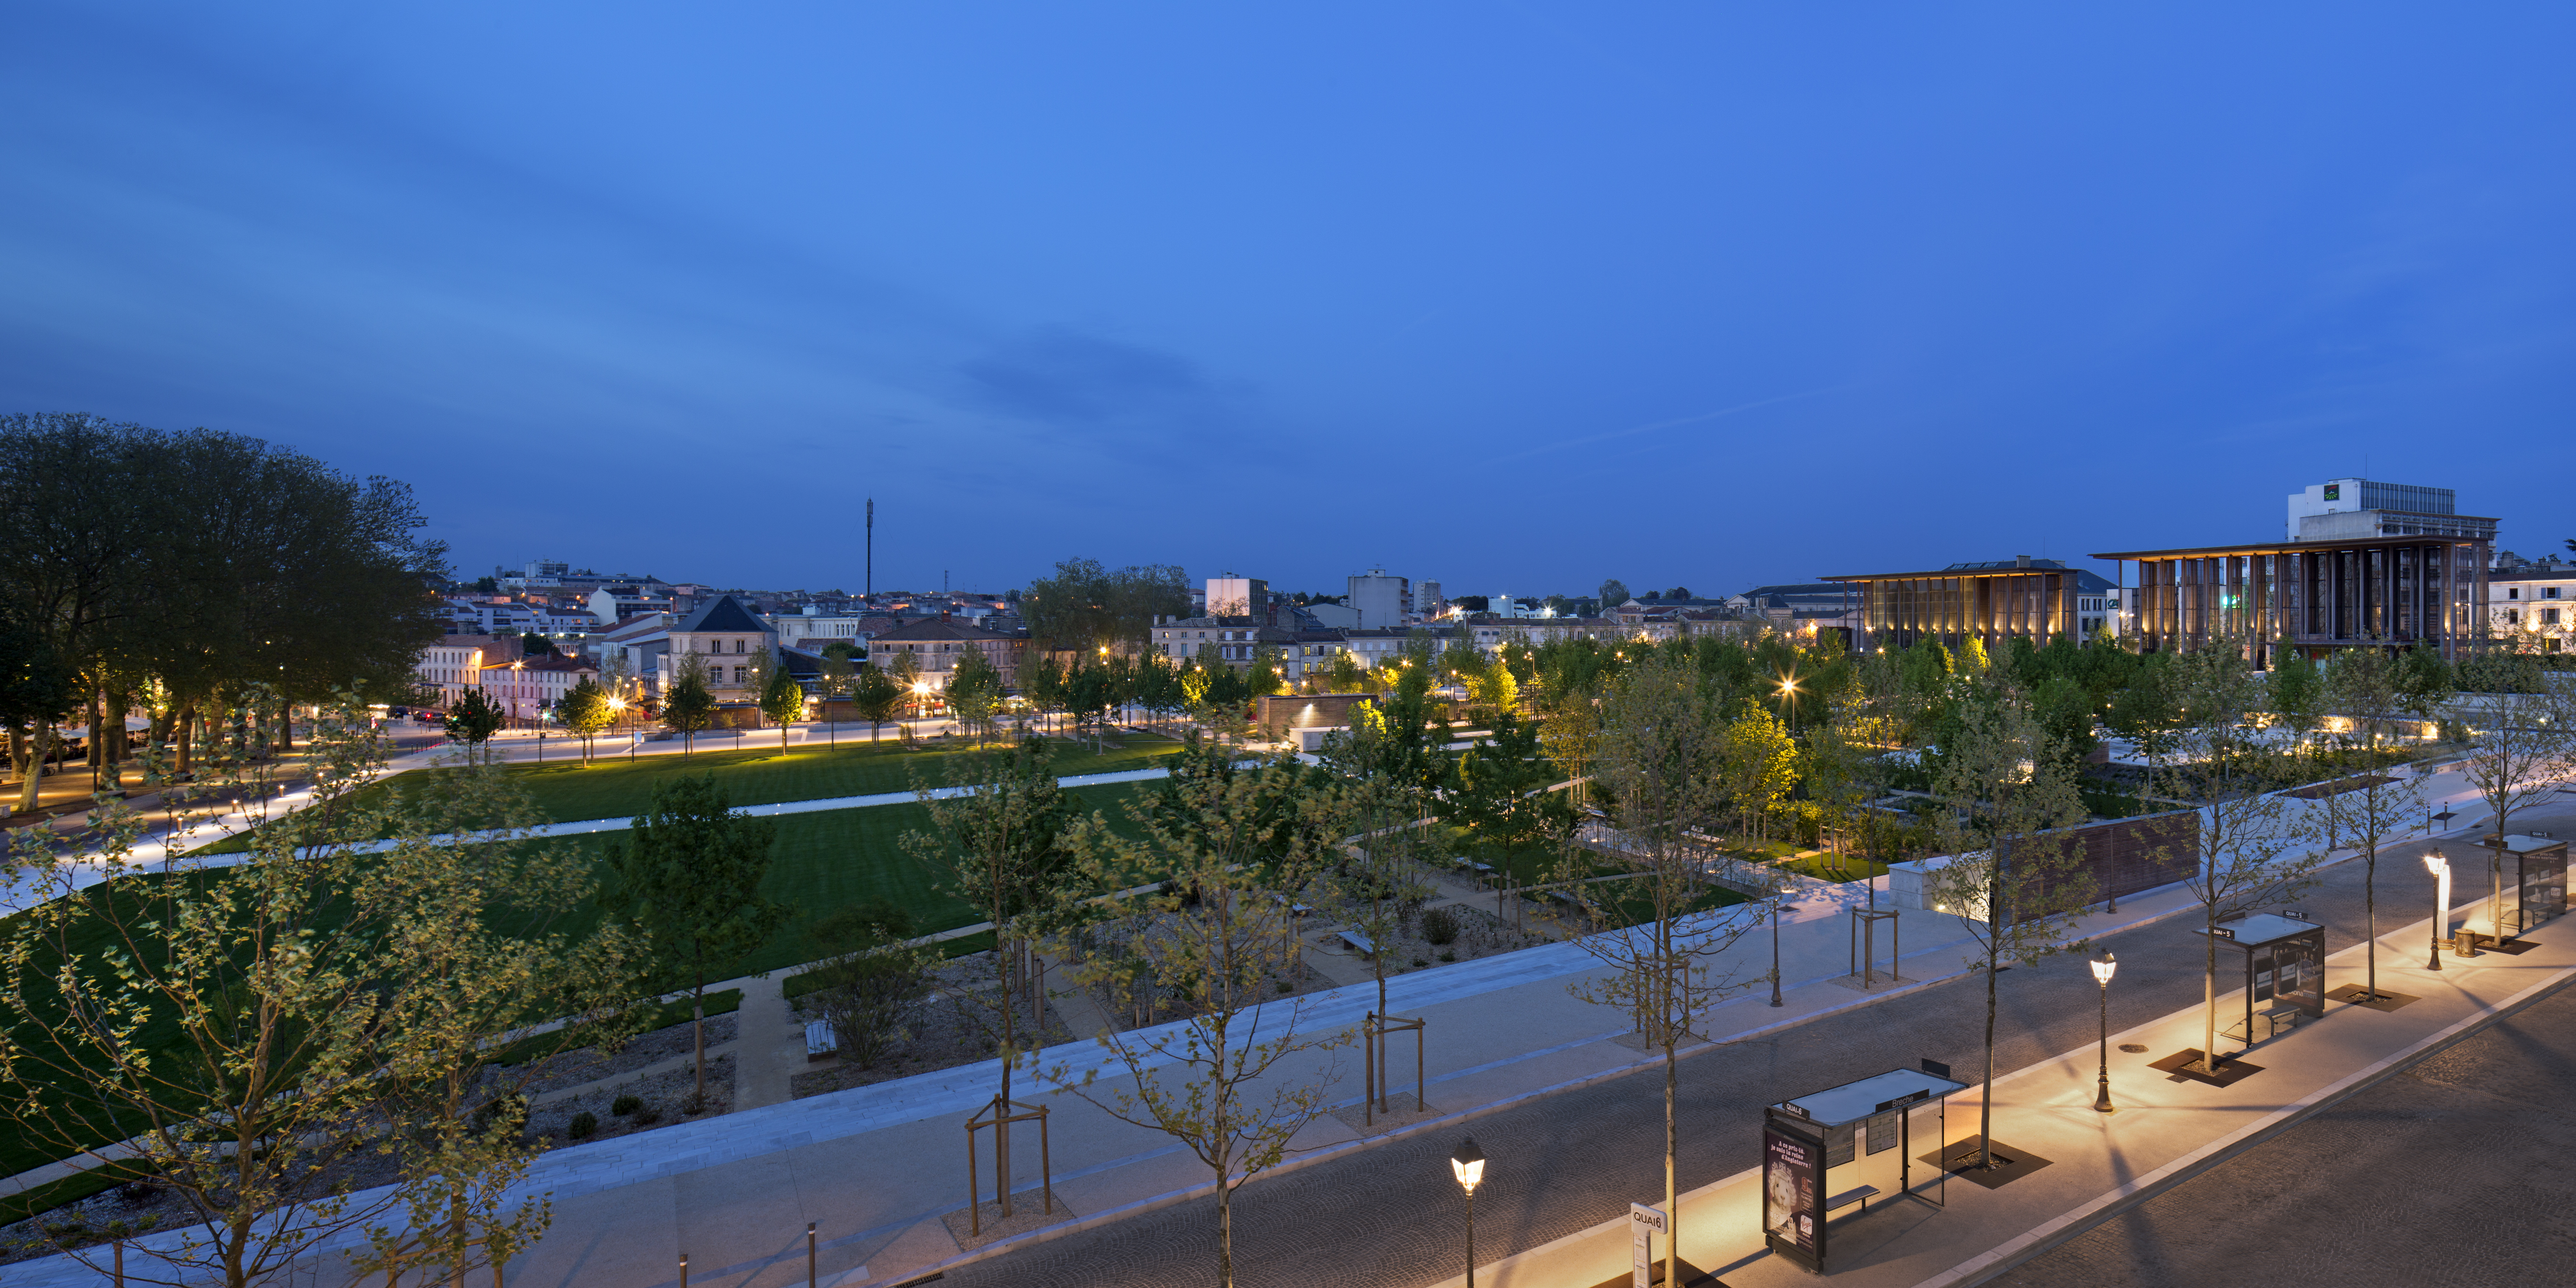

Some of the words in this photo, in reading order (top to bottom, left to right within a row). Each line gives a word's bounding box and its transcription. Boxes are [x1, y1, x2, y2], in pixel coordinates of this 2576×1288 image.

[1892, 1096, 1913, 1108] Breche
[1781, 1154, 1808, 1168] d'Angleterre
[1801, 1217, 1812, 1232] Virgin
